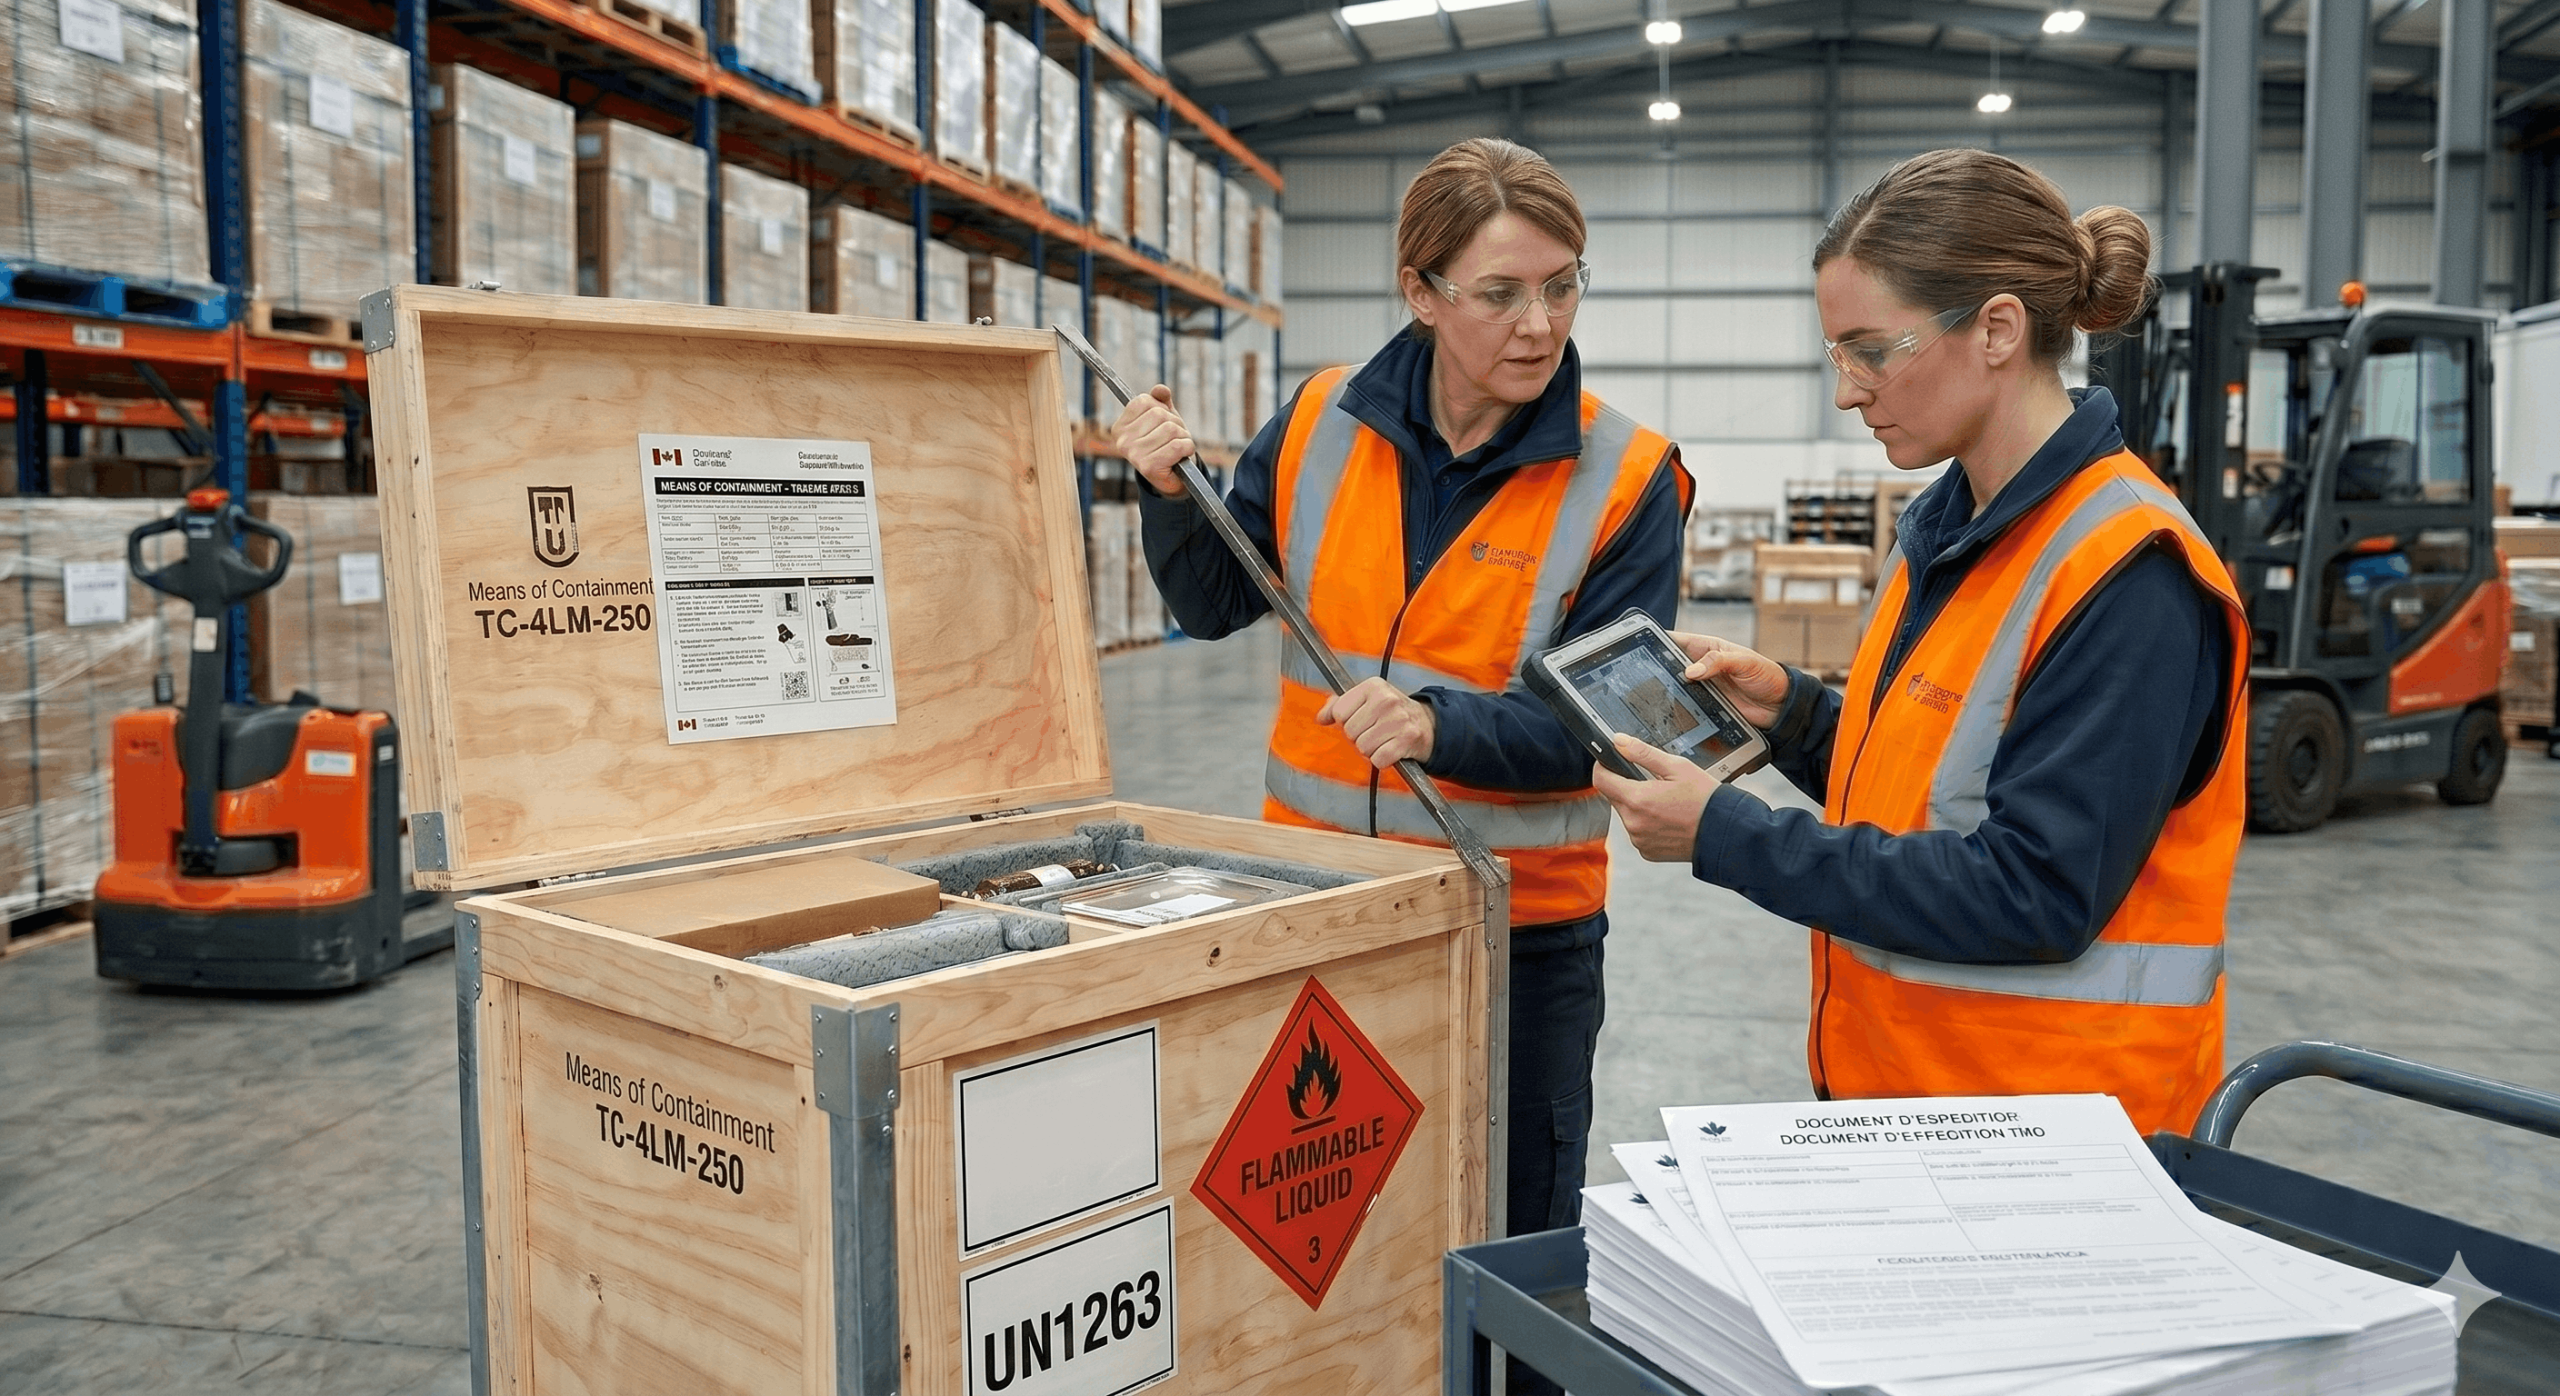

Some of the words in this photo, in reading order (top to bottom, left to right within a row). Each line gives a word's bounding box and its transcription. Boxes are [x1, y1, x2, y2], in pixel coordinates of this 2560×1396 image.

[661, 481, 697, 492] MEANS
[699, 482, 712, 492] OF
[714, 483, 782, 494] CONTAINMENT
[468, 582, 526, 601] Means
[531, 580, 547, 599] of
[552, 577, 654, 599] Containment
[474, 603, 651, 639] TC-4LM-250
[566, 1051, 622, 1098] Means
[628, 1078, 646, 1106] of
[652, 1082, 776, 1154] Containment
[1780, 1132, 1879, 1146] DOCUMENT
[1795, 1115, 1893, 1130] DOCUMENT
[596, 1103, 744, 1195] TC-4LM-250
[1241, 1116, 1385, 1196] FLAMMABLE
[1275, 1167, 1354, 1225] LIQUID
[1308, 1235, 1321, 1264] 3
[984, 1270, 1162, 1392] UN1263
